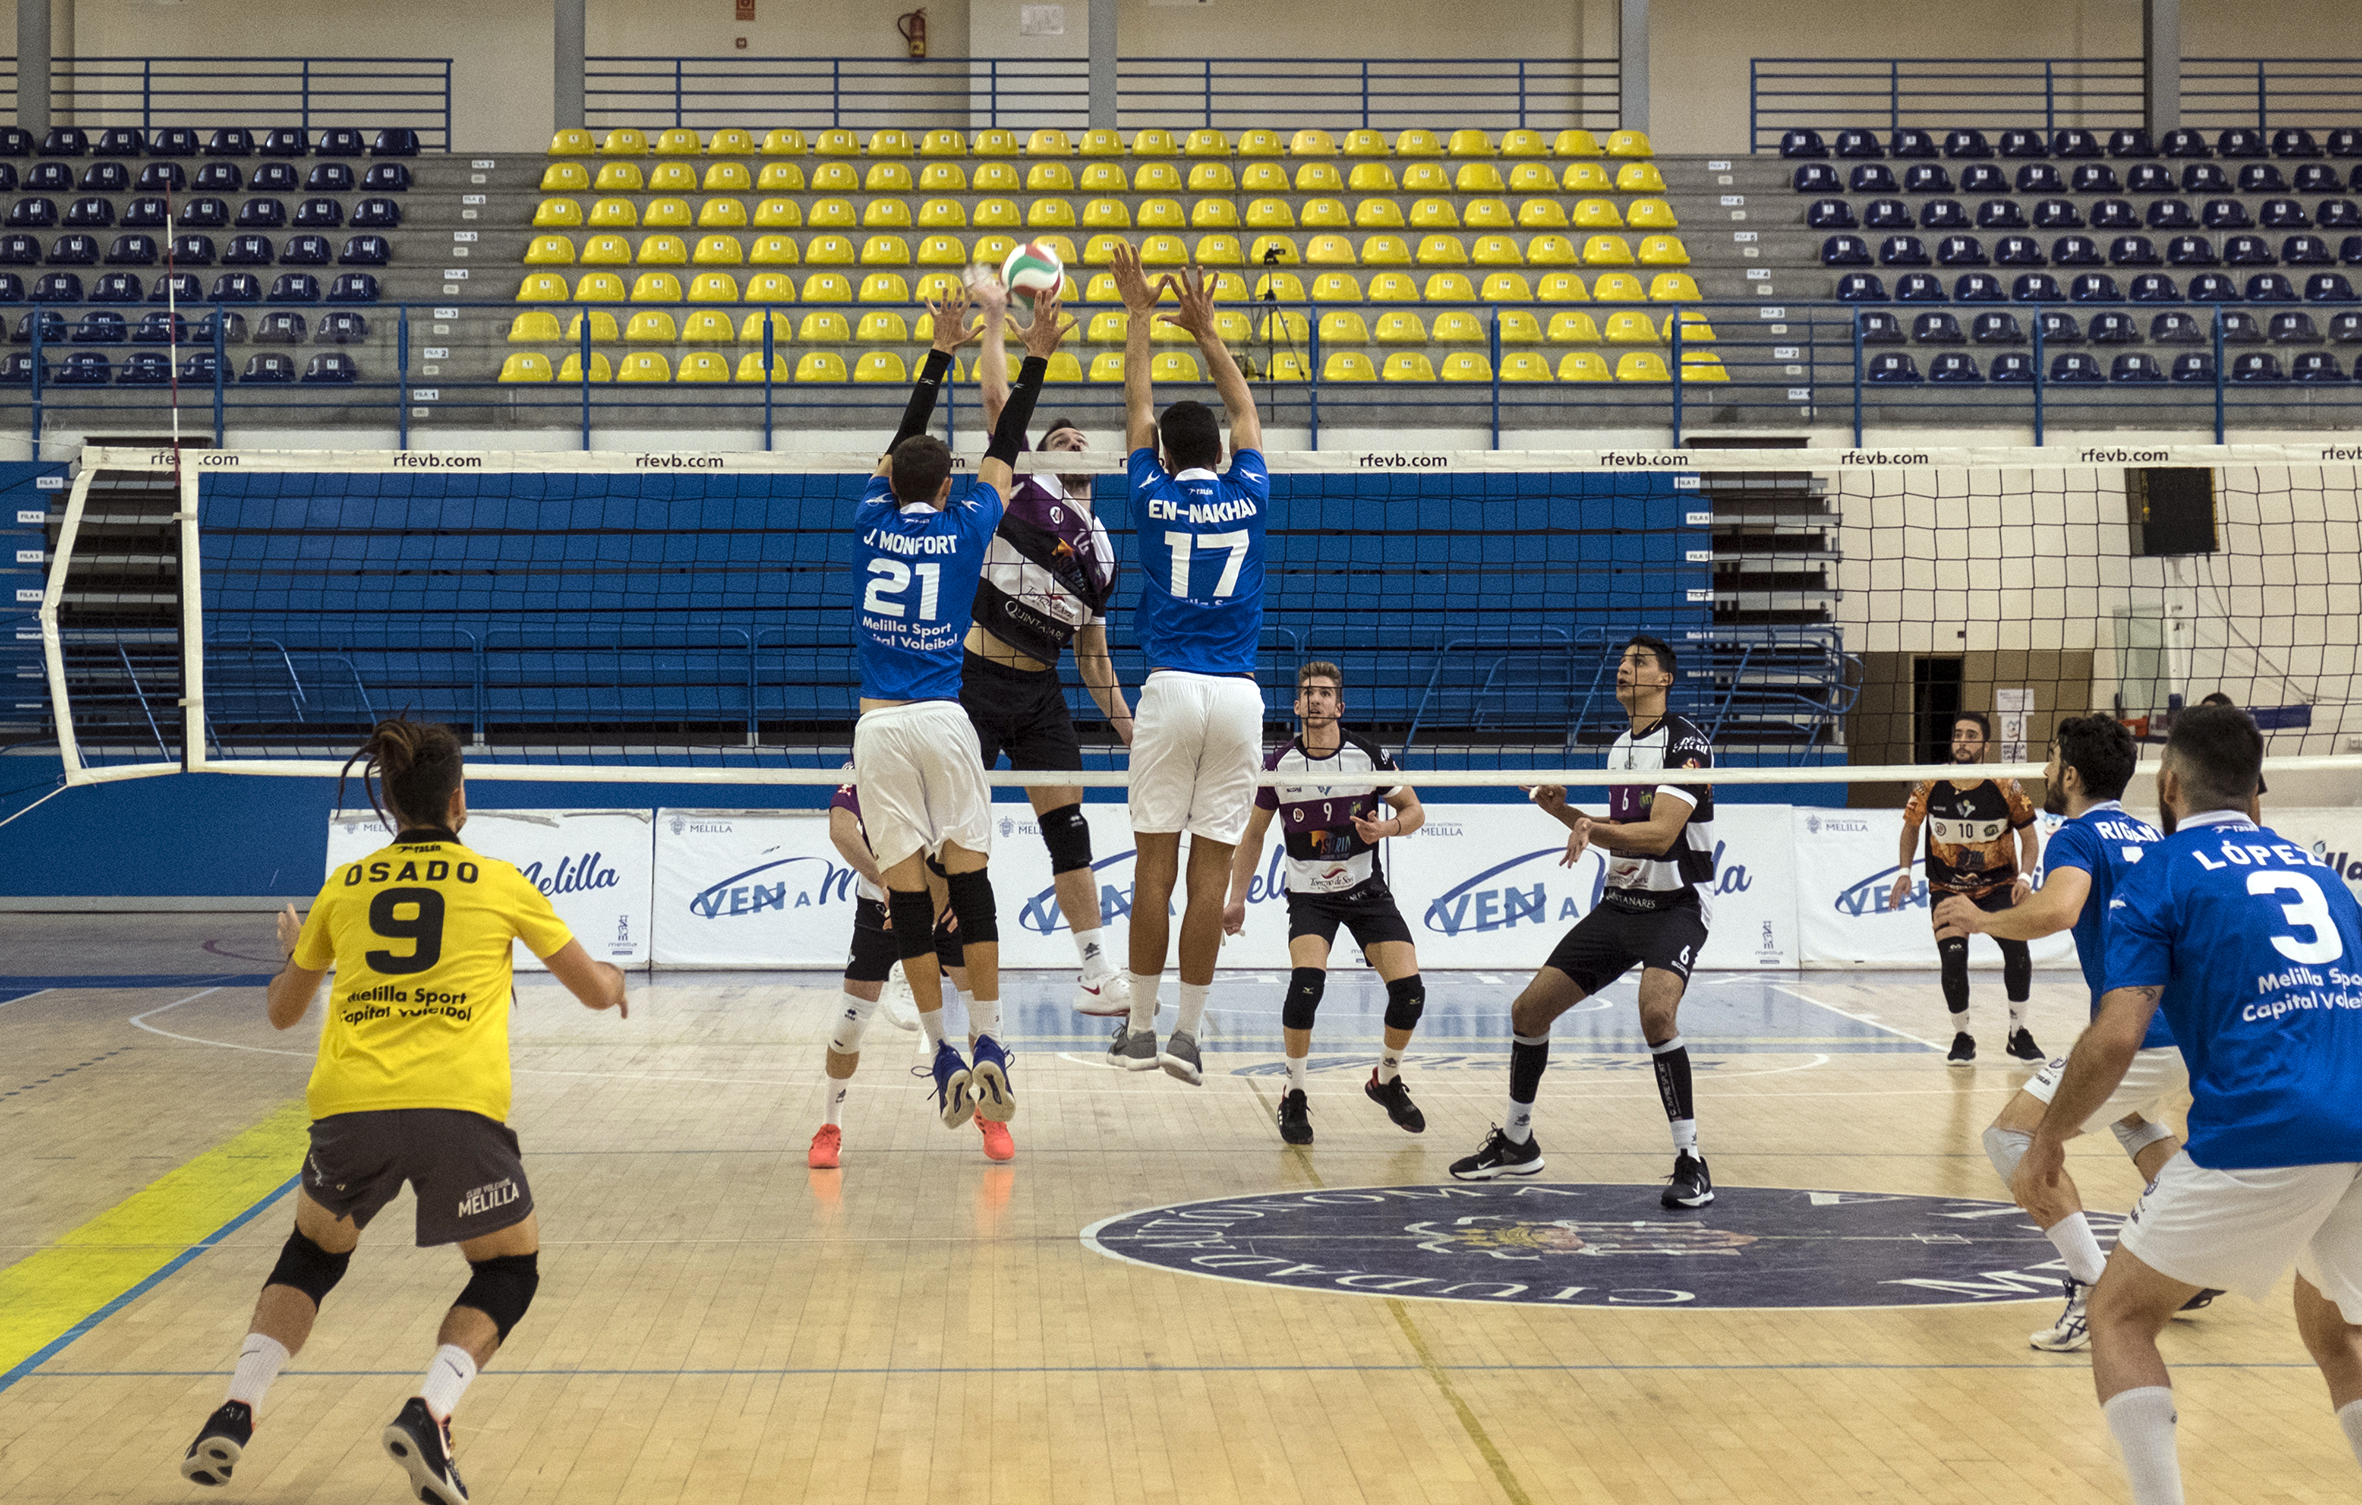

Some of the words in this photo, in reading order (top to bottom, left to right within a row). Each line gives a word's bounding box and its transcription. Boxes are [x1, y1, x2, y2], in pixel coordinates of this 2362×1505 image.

[151, 451, 239, 466] rfe.com
[393, 453, 482, 468] rfevb.com
[636, 454, 724, 469] rfevb.com
[1360, 453, 1447, 468] rfevb.com
[1601, 451, 1688, 467] rfevb.com
[1841, 450, 1928, 465] rfevb.com
[2082, 448, 2169, 463] rfevb.com
[863, 528, 874, 547] J.
[878, 530, 958, 556] MONFORT
[1164, 528, 1250, 598] 17
[862, 557, 941, 621] 21
[862, 616, 907, 633] Melilla
[912, 622, 952, 638] Sport
[900, 632, 958, 651] Voleibol
[1622, 788, 1630, 810] 6
[1323, 802, 1332, 822] 9
[689, 824, 733, 833] MELILLA
[1420, 827, 1464, 836] MELILLA
[1826, 823, 1869, 832] MELILLA
[1958, 823, 1974, 838] 10
[2192, 840, 2329, 871] LÓPEZ
[344, 860, 479, 886] OSADO
[697, 881, 786, 920] VEN
[794, 891, 812, 908] A
[1432, 882, 1546, 937] VEN
[1558, 896, 1580, 922] A
[2246, 870, 2344, 965] 3
[364, 887, 446, 975] 9
[1680, 944, 1690, 965] 6
[2258, 967, 2324, 994] Melilla
[414, 988, 467, 1006] Sport
[2242, 990, 2318, 1022] Capital
[2320, 990, 2362, 1010] Vole
[458, 1182, 520, 1218] MELILLA
